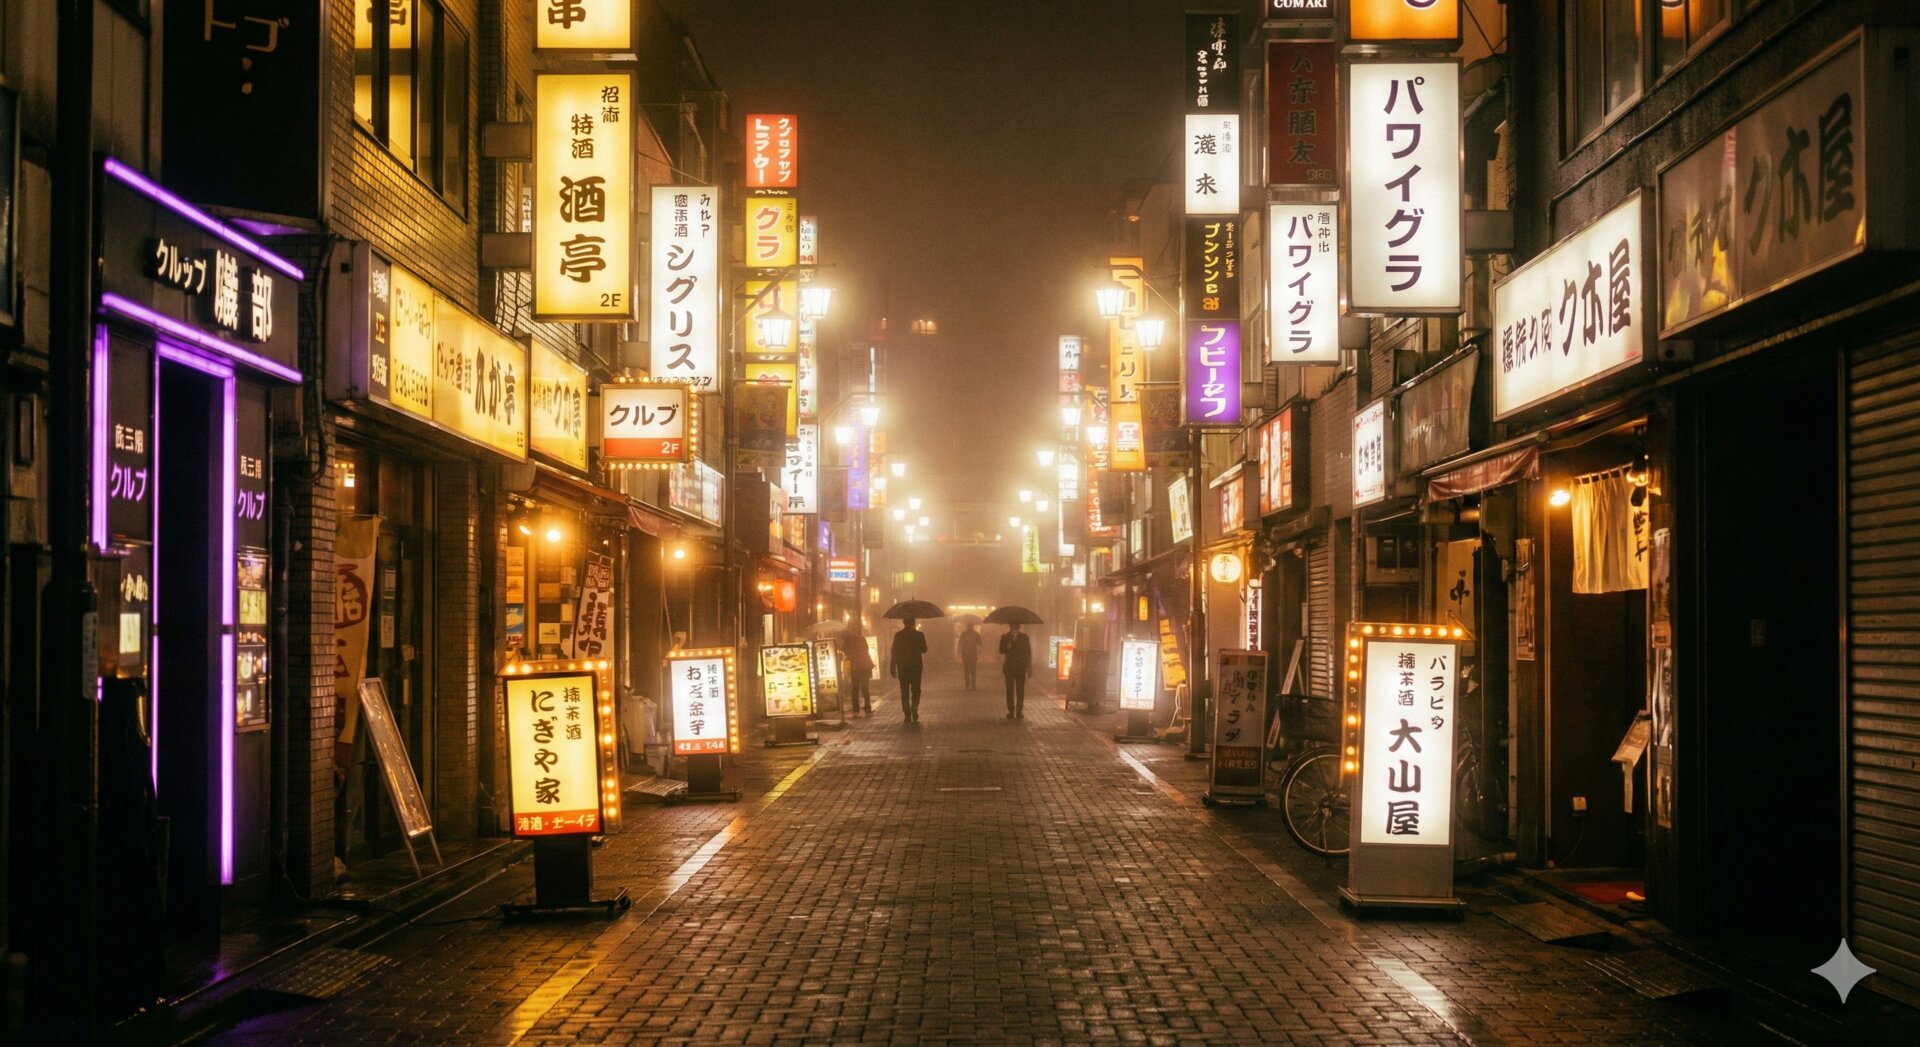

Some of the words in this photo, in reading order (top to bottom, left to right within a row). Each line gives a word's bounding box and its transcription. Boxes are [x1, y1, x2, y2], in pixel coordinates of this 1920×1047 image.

[571, 113, 594, 159] 特酒
[1383, 76, 1425, 292] パワイグラ
[559, 175, 607, 284] 酒亭
[1288, 213, 1314, 354] パワイグラ
[609, 404, 679, 427] クルブ
[661, 441, 679, 454] 2F
[530, 689, 561, 805] にぎや家
[1385, 718, 1423, 836] 大山屋
